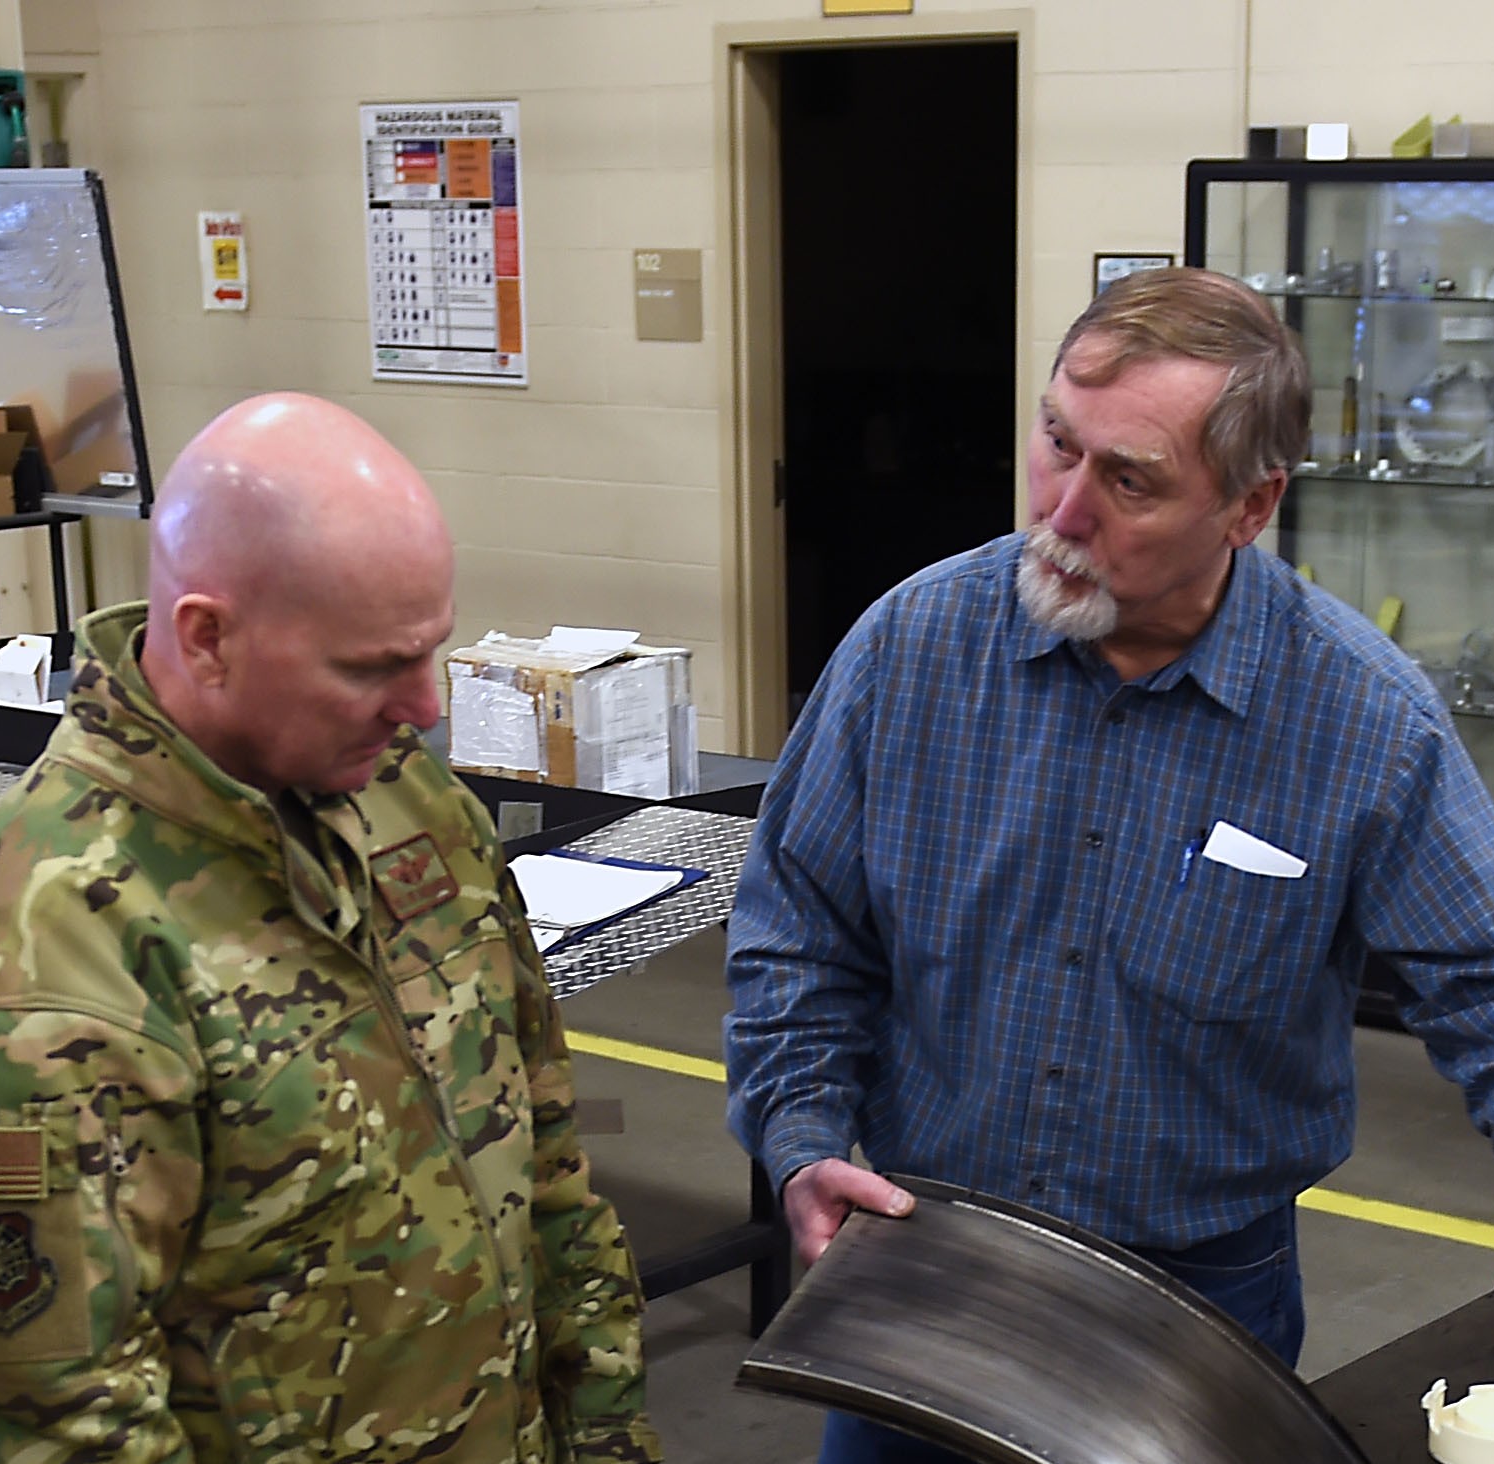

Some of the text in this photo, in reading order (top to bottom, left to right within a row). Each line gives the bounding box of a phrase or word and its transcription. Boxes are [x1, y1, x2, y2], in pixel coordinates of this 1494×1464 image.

[376, 110, 501, 122] HAZARDOUS MATERIAL
[376, 122, 502, 135] IDENTIFICATION GUIDE
[637, 254, 660, 271] 102
